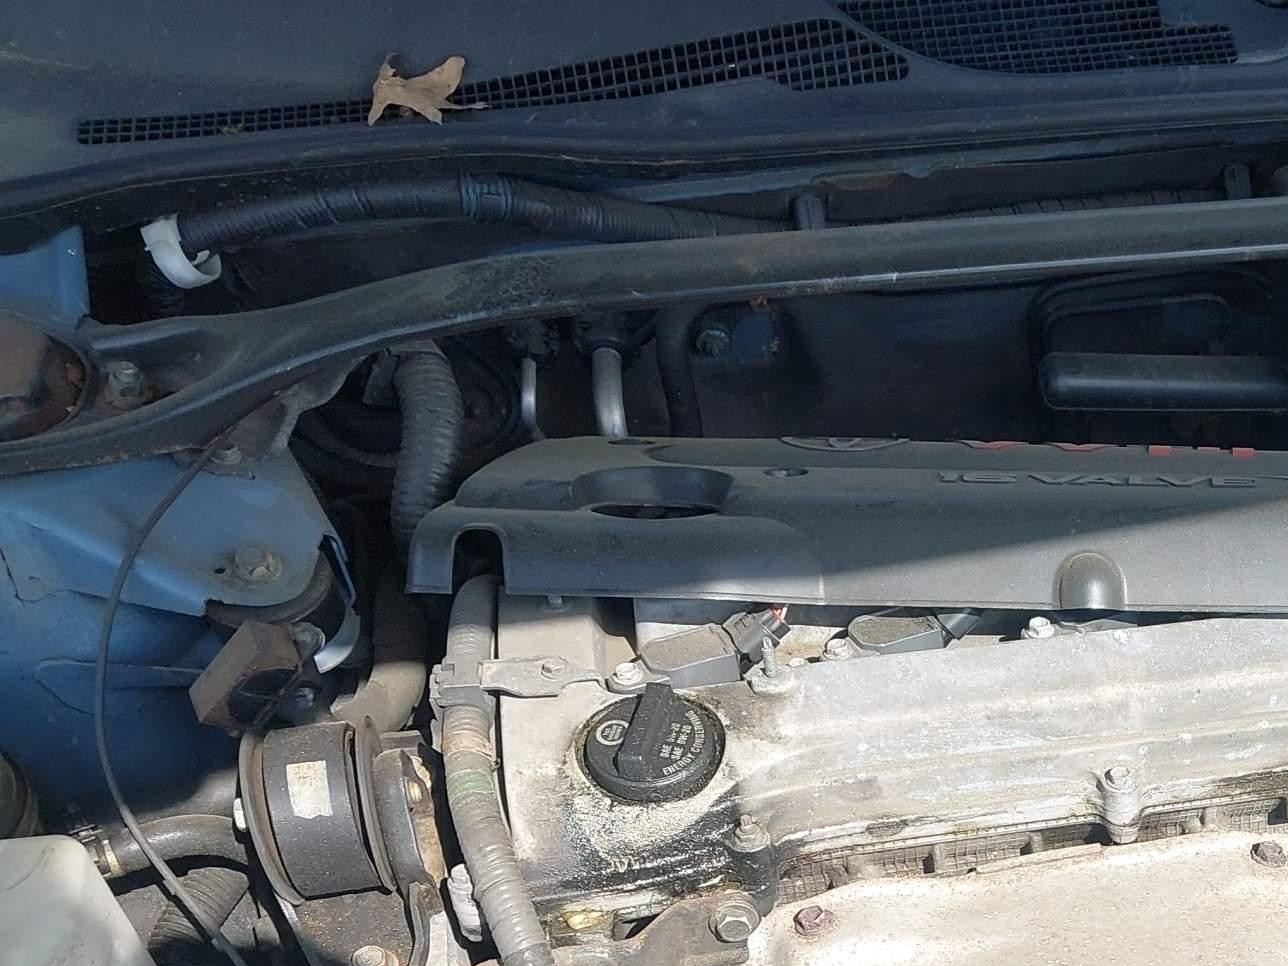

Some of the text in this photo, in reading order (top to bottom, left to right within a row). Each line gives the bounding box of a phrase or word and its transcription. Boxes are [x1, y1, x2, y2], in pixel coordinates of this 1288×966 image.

[660, 744, 672, 758] SAE
[671, 747, 684, 760] SAE
[662, 753, 696, 776] ENERGY
